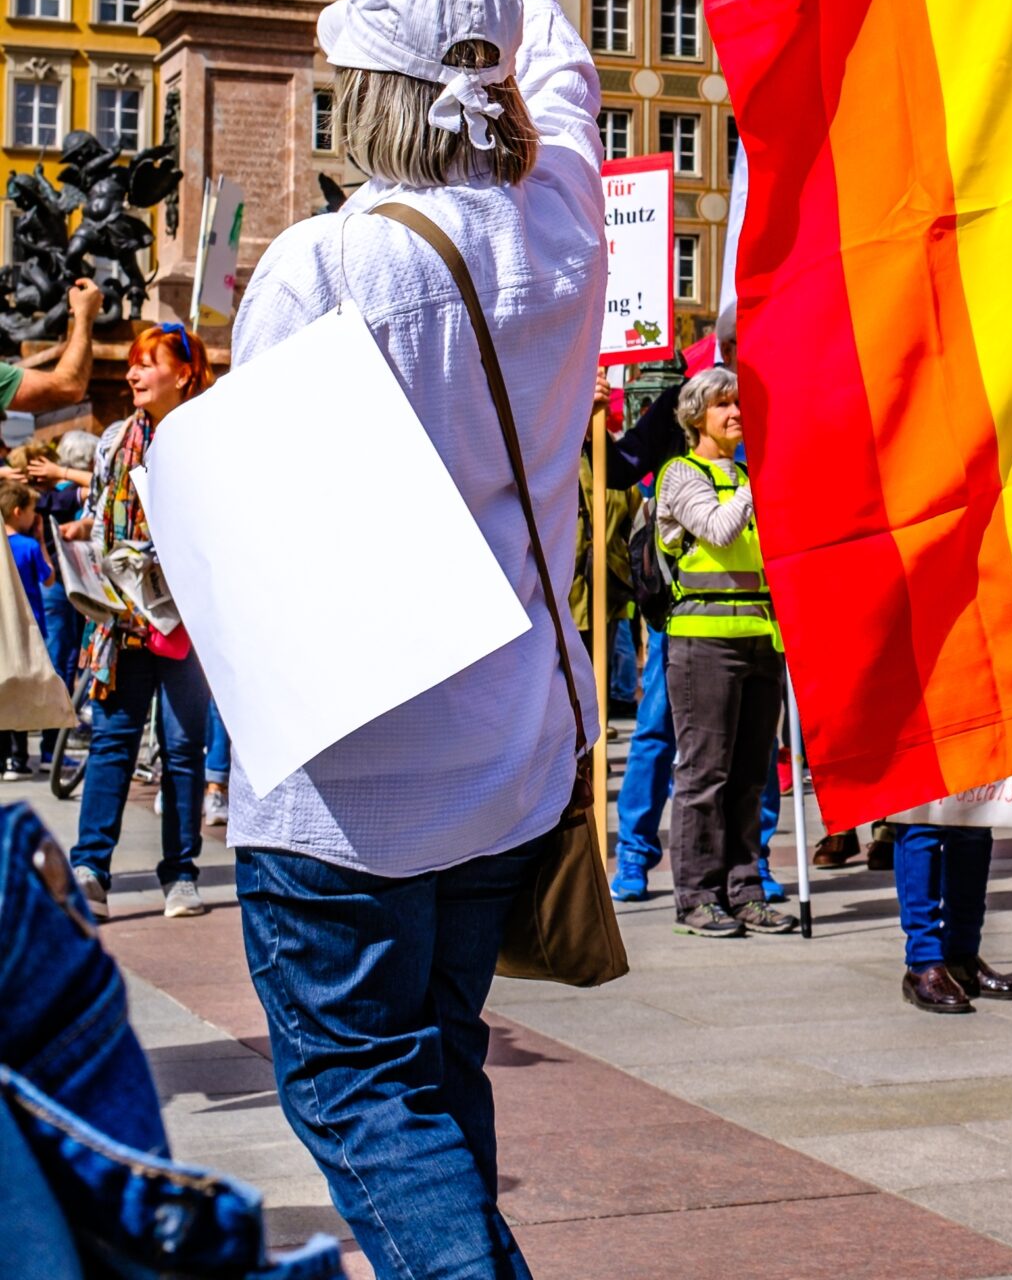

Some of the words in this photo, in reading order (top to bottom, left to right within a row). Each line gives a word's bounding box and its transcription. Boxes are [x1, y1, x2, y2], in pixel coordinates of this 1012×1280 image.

[607, 180, 636, 197] für
[604, 207, 656, 226] chutz
[608, 297, 631, 317] ng
